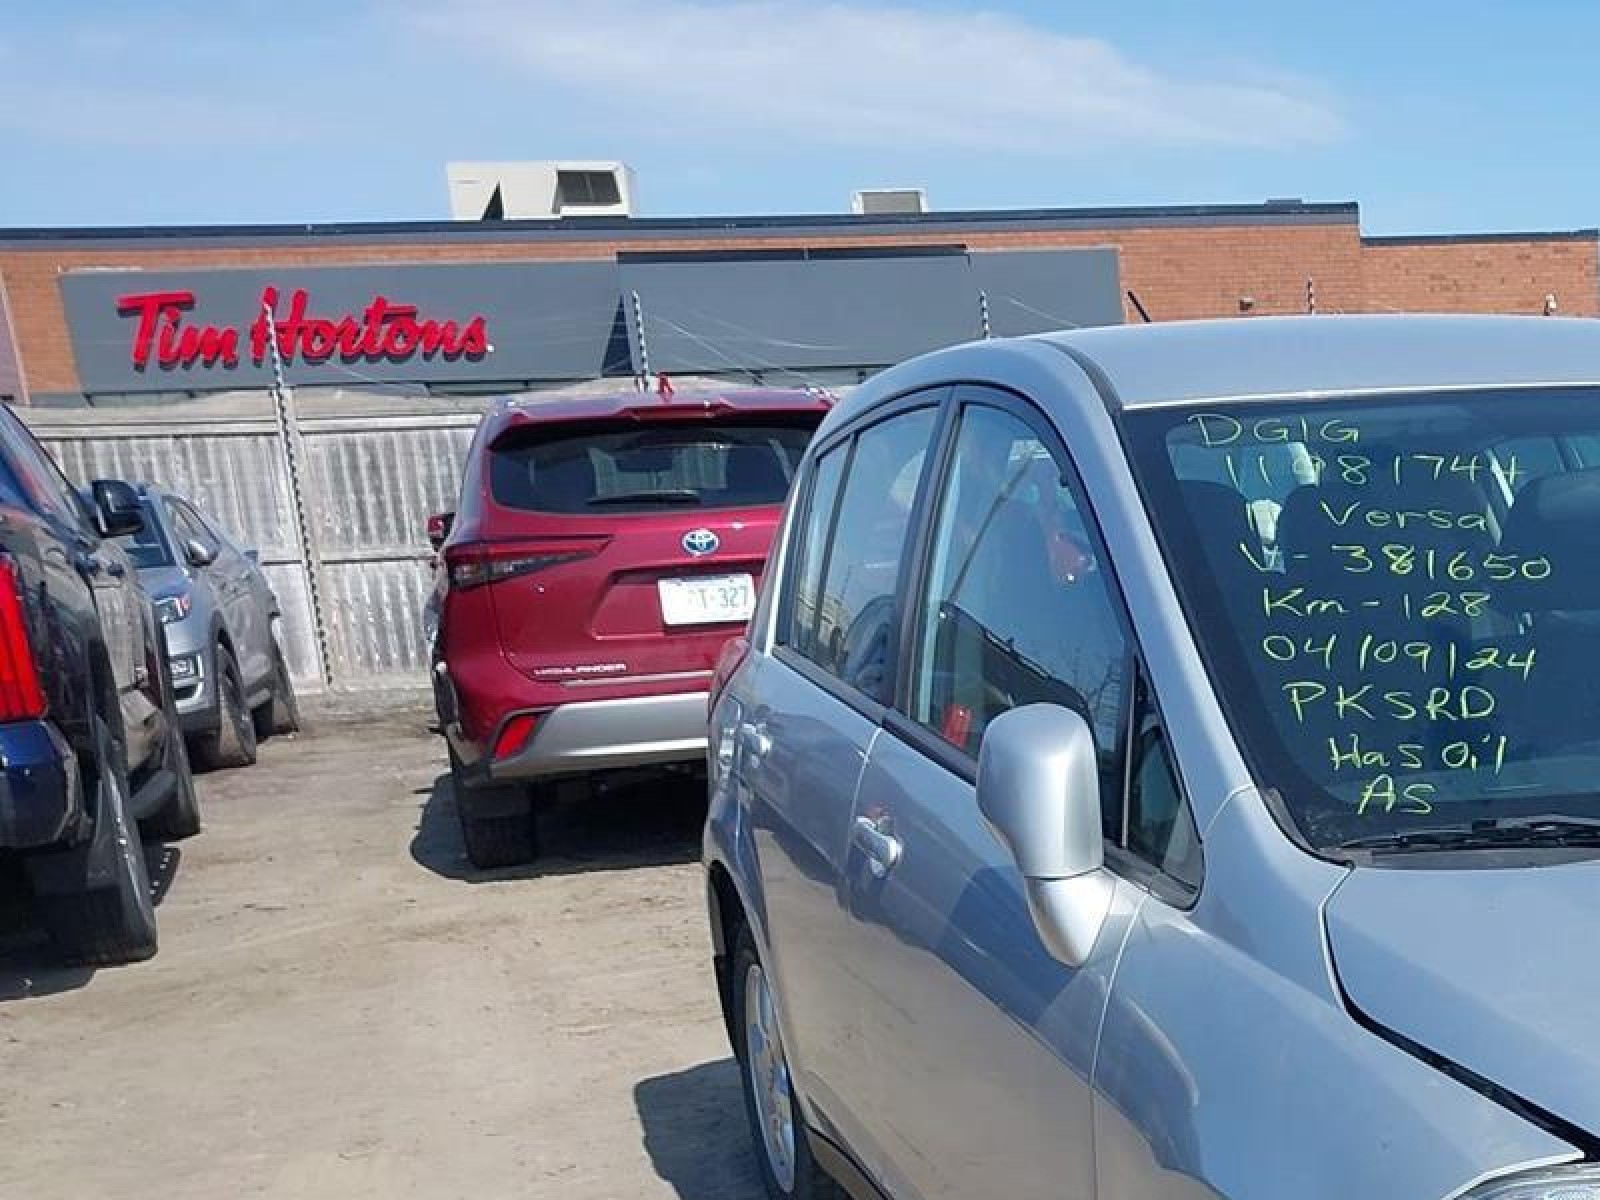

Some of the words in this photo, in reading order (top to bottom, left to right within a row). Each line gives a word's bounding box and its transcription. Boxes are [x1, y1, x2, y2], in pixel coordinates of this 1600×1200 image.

[116, 291, 239, 370] Tim
[251, 286, 488, 365] Hortons
[1225, 454, 1529, 489] 11981744
[1320, 500, 1489, 530] Versa
[1357, 773, 1437, 816] AS
